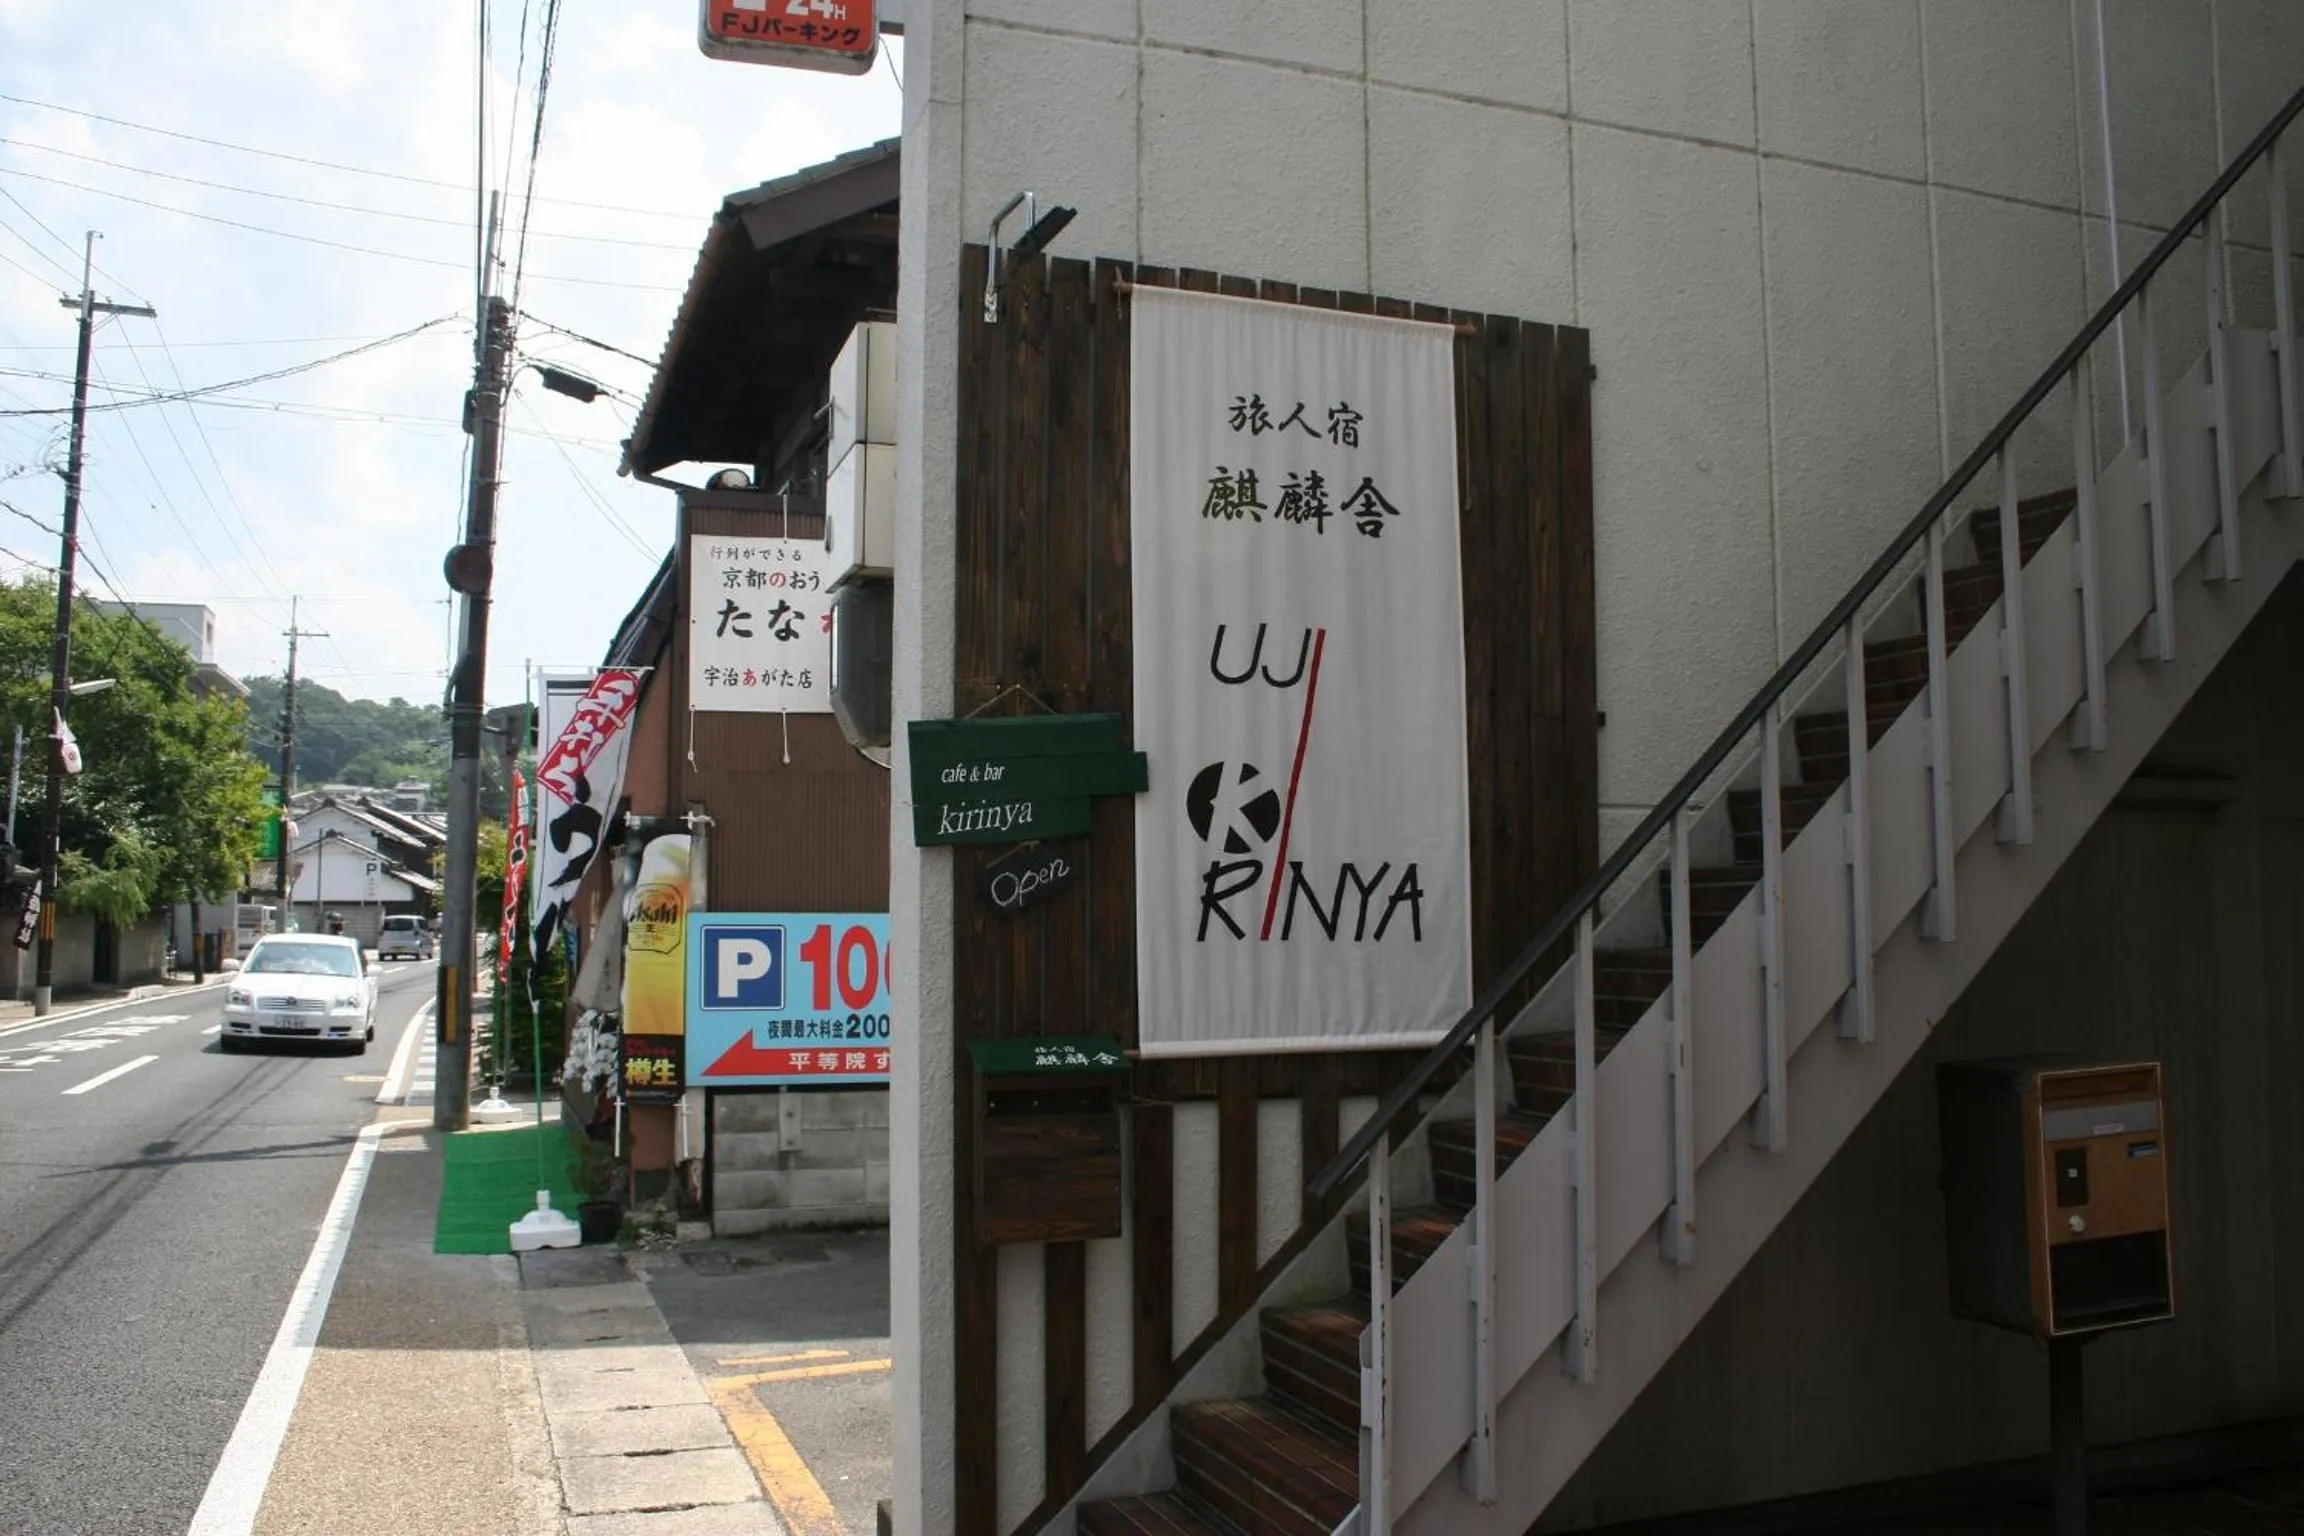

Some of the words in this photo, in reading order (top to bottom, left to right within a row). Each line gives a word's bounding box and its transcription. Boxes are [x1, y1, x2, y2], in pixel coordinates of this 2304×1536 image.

[1228, 394, 1364, 448] 旅人宿
[1202, 466, 1400, 539] 麒麟舎
[711, 546, 801, 561] 行列ができる
[722, 567, 820, 591] 京都のおう
[716, 598, 833, 642] たな
[704, 665, 813, 689] 宇治あがた店
[941, 763, 967, 783] cafe
[969, 766, 981, 782] &
[984, 763, 1005, 781] bar
[937, 800, 1033, 835] kirinya
[991, 858, 1071, 907] Open
[718, 938, 772, 998] P
[800, 924, 890, 1011] 10
